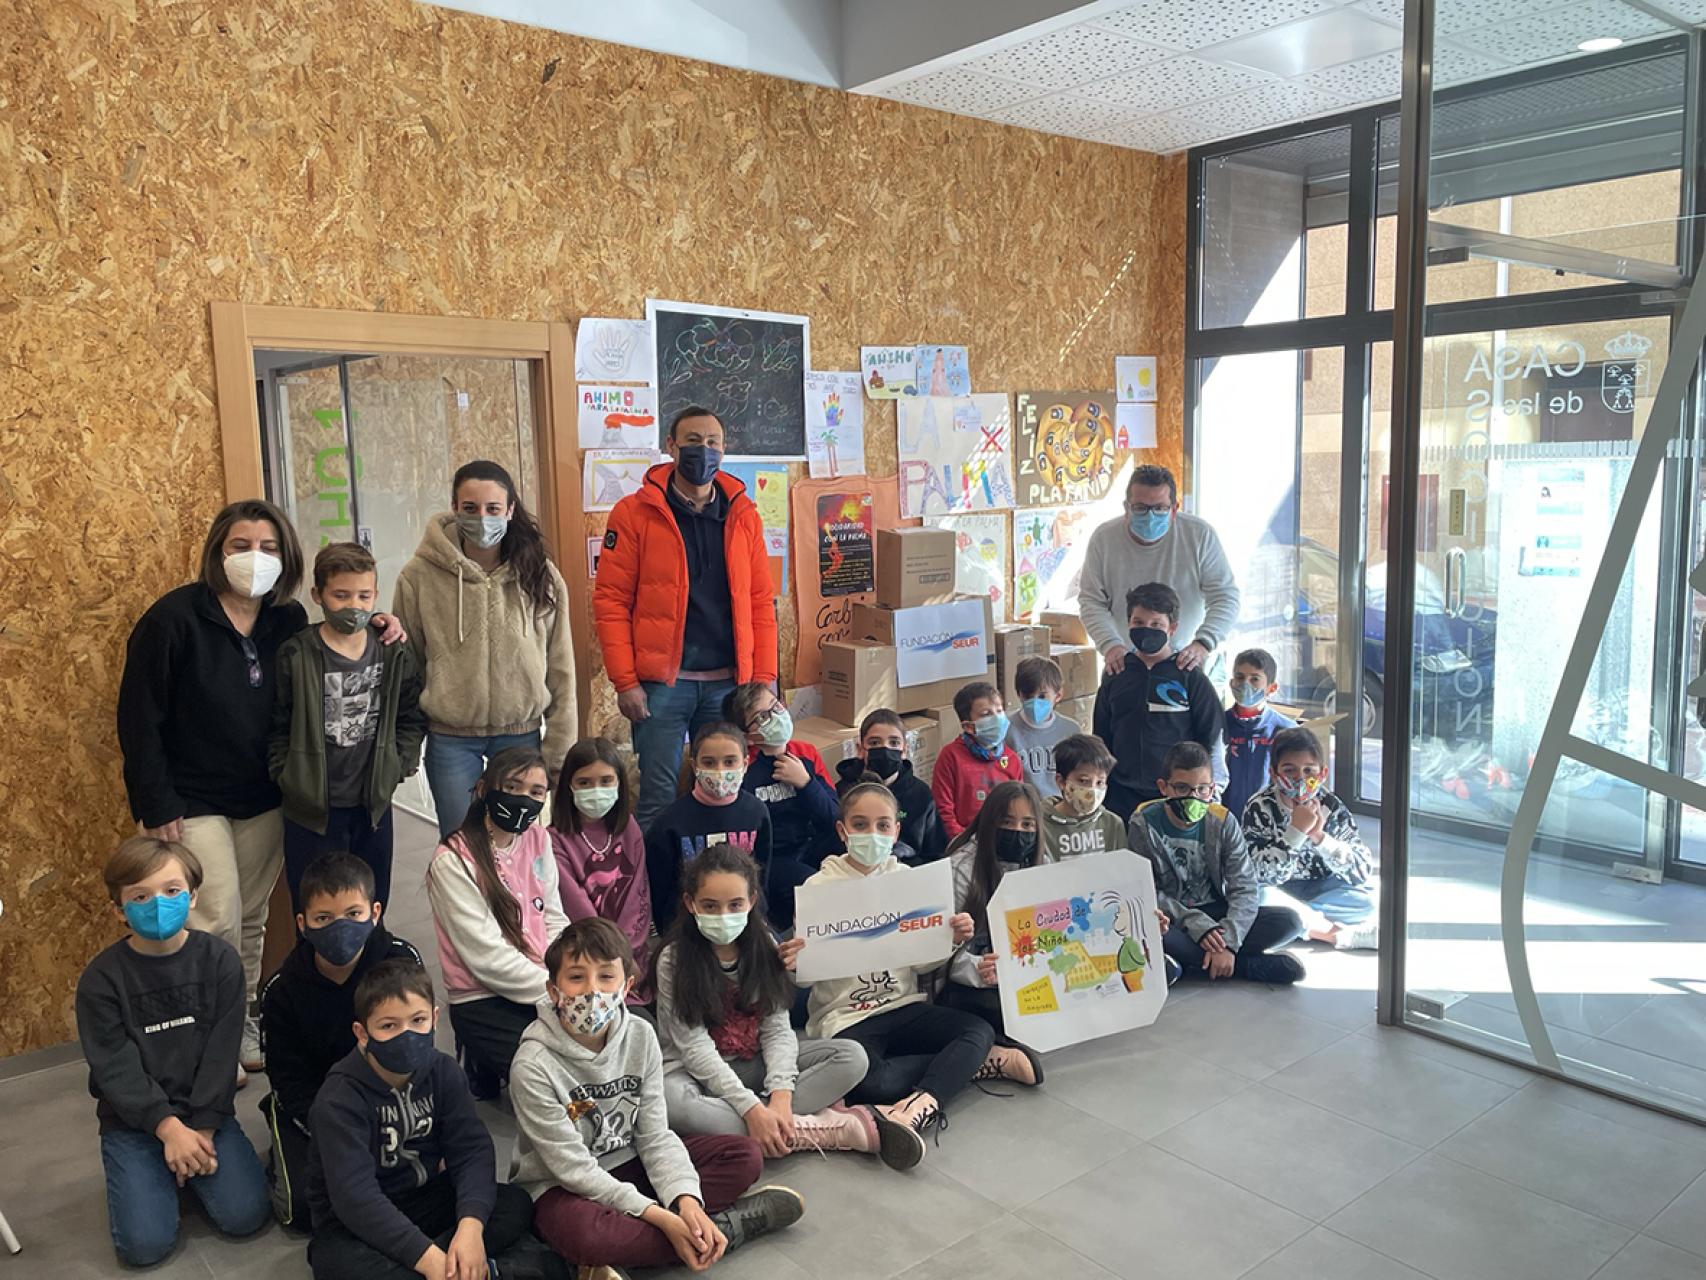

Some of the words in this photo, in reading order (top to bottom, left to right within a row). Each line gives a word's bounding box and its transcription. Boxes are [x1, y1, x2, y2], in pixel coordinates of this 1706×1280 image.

[952, 636, 979, 650] SEUR
[1058, 829, 1106, 854] SOME
[806, 911, 900, 938] FUNDACIÓN
[898, 914, 943, 933] SEUR
[1035, 906, 1072, 927] Ciudad
